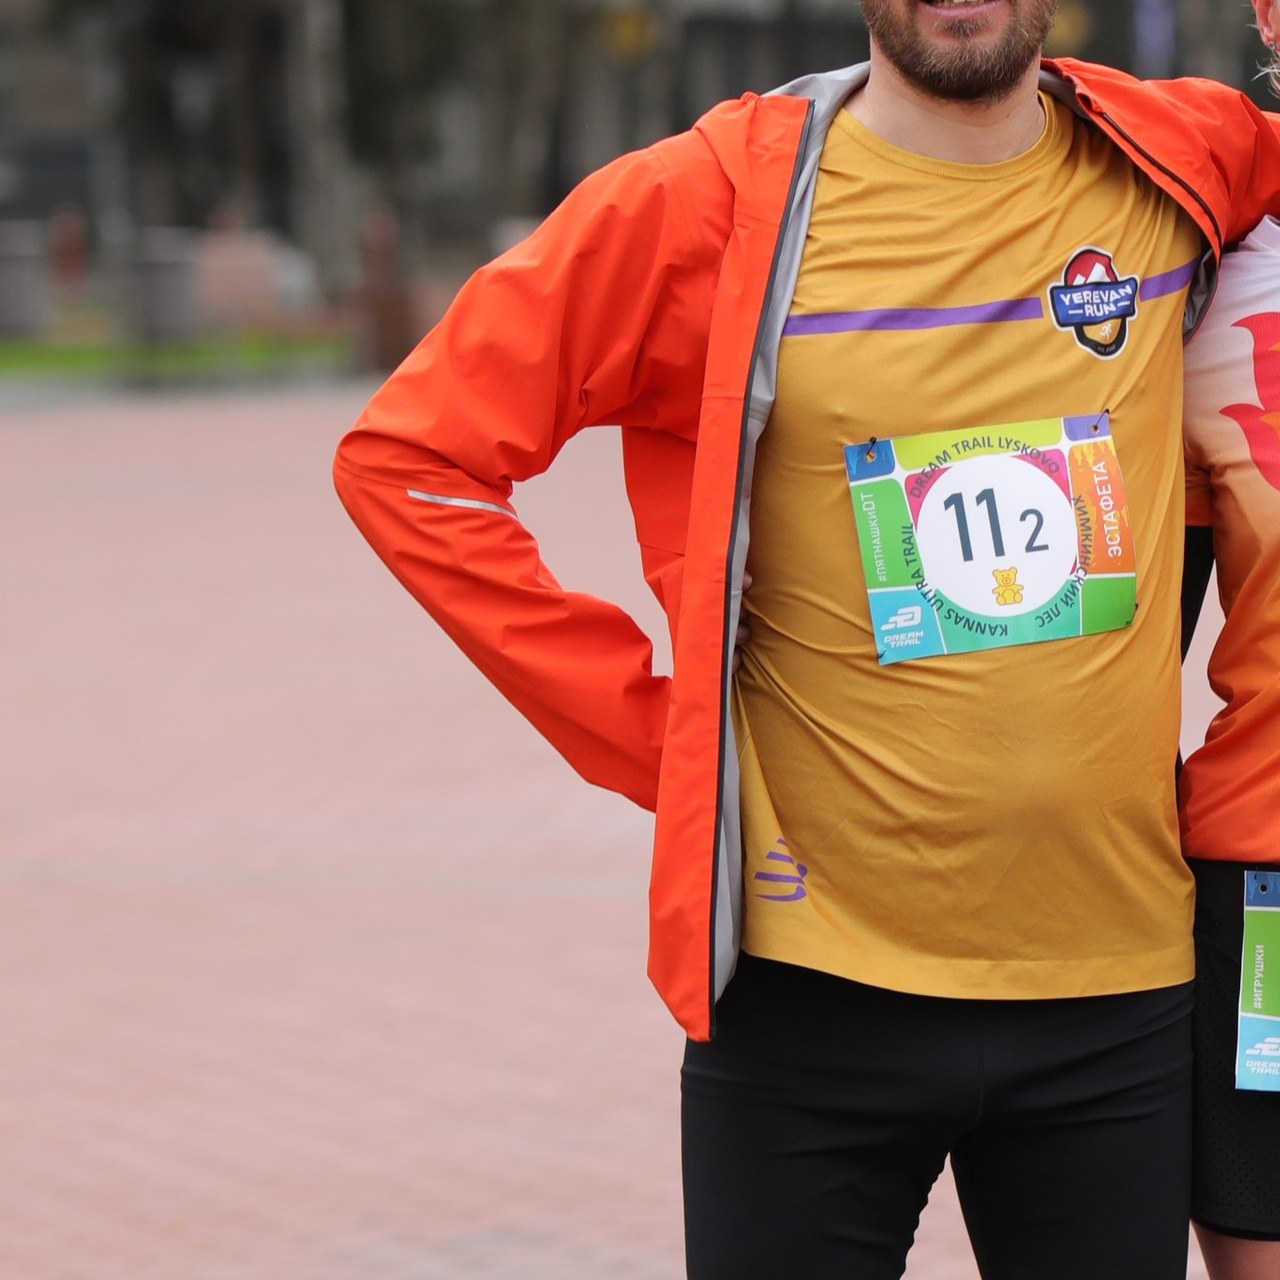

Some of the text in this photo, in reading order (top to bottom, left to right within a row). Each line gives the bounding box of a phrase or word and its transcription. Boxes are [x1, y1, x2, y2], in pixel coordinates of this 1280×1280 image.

[1060, 284, 1132, 306] YEREVAN
[1085, 303, 1116, 316] RUN
[910, 436, 1060, 499] DREAM TRAIL LYSKOVO
[943, 488, 1049, 562] 11 2
[1096, 460, 1122, 558] ЭСТАФЕТА
[902, 522, 918, 568] TRAIL
[1035, 494, 1092, 628] ХИМКИНСКИЙ ЛЕС
[944, 608, 1008, 636] KANNAS
[1253, 944, 1264, 1009] #ИГРУШКИ
